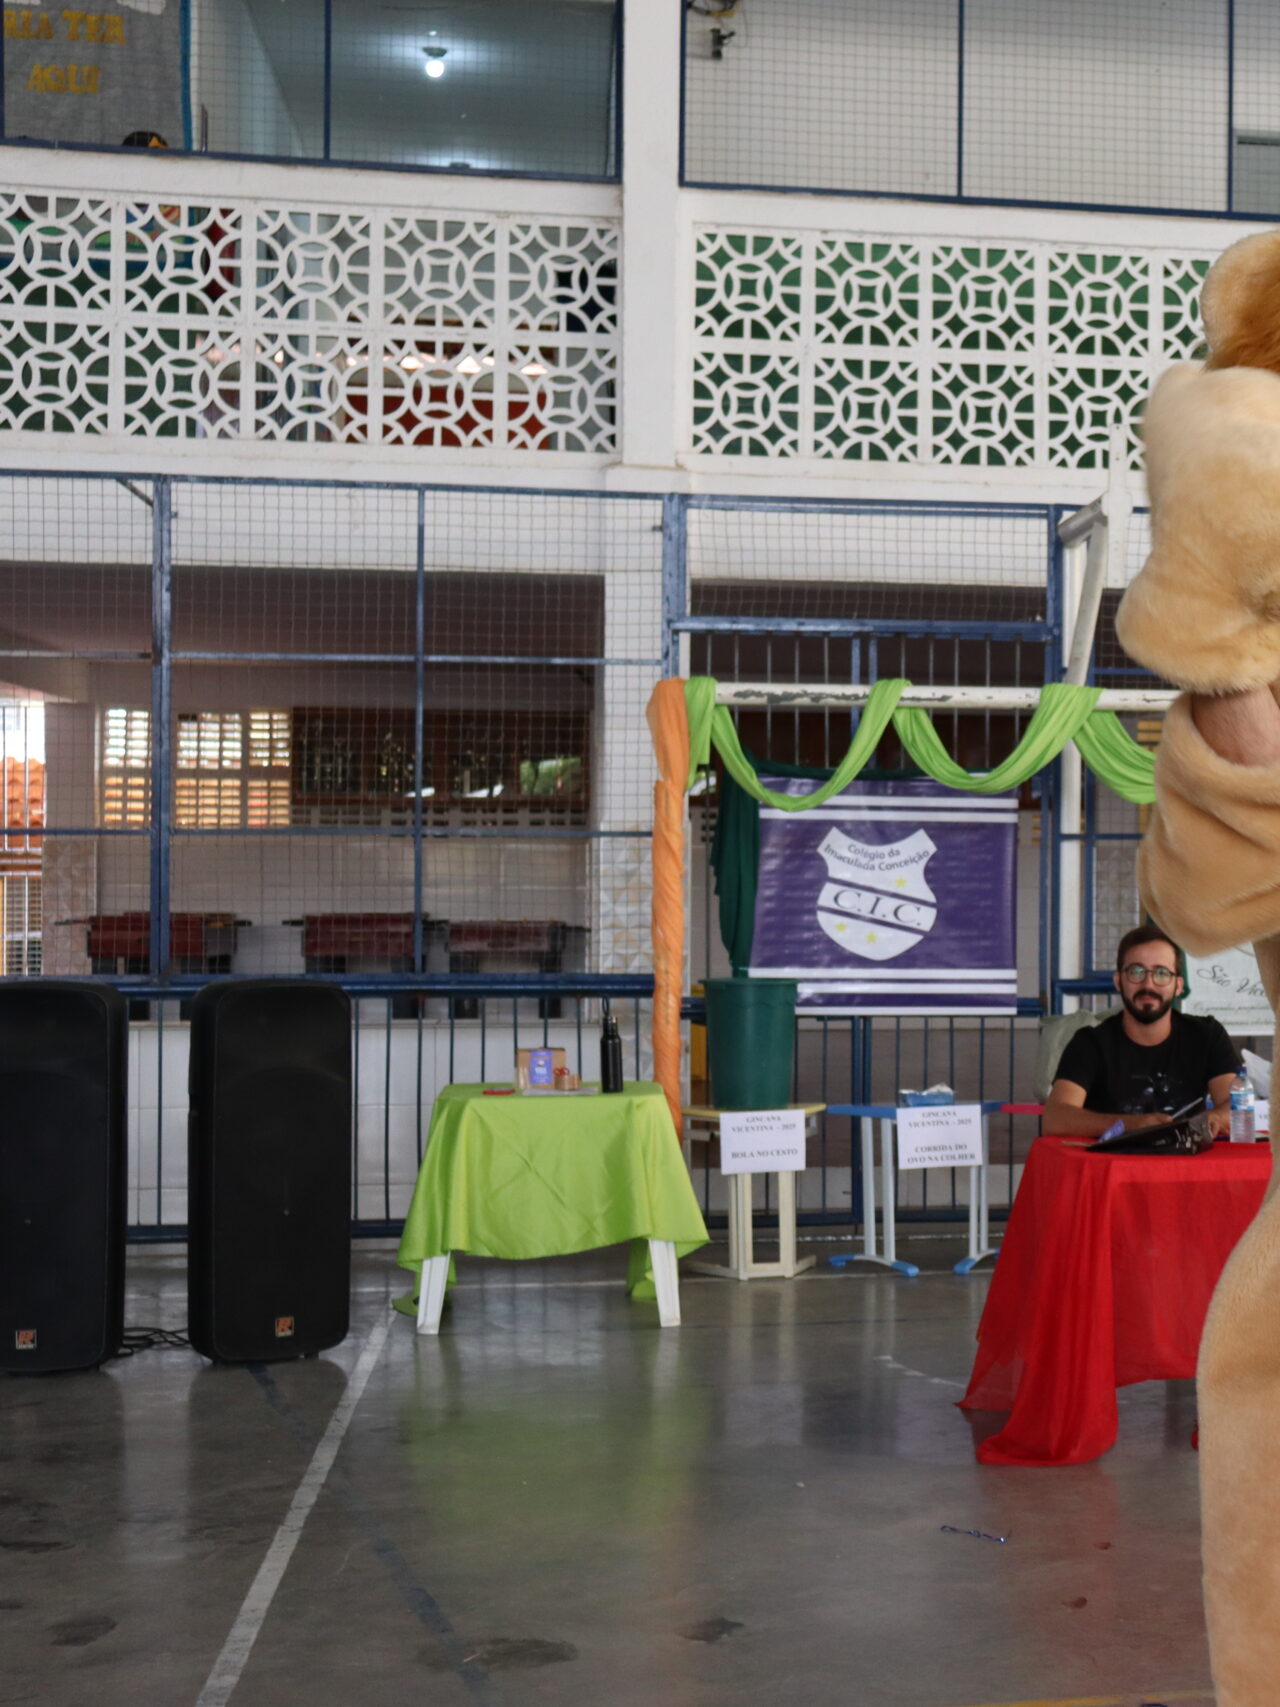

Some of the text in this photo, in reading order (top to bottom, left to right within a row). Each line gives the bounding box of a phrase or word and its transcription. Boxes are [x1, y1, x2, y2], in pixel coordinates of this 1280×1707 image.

[62, 10, 126, 45] TER
[25, 63, 101, 94] AQUI
[823, 843, 930, 871] Imaculada Conceição
[847, 844, 901, 860] Colégio da
[745, 1115, 782, 1123] GINCANA
[908, 1120, 950, 1128] VICENTINA
[731, 1125, 774, 1133] VICENTINA
[731, 1151, 755, 1159] BOLA
[770, 1148, 798, 1157] CESTO
[914, 1144, 953, 1153] CORRIDA
[907, 1155, 926, 1164] OVO
[940, 1153, 976, 1161] COLHER
